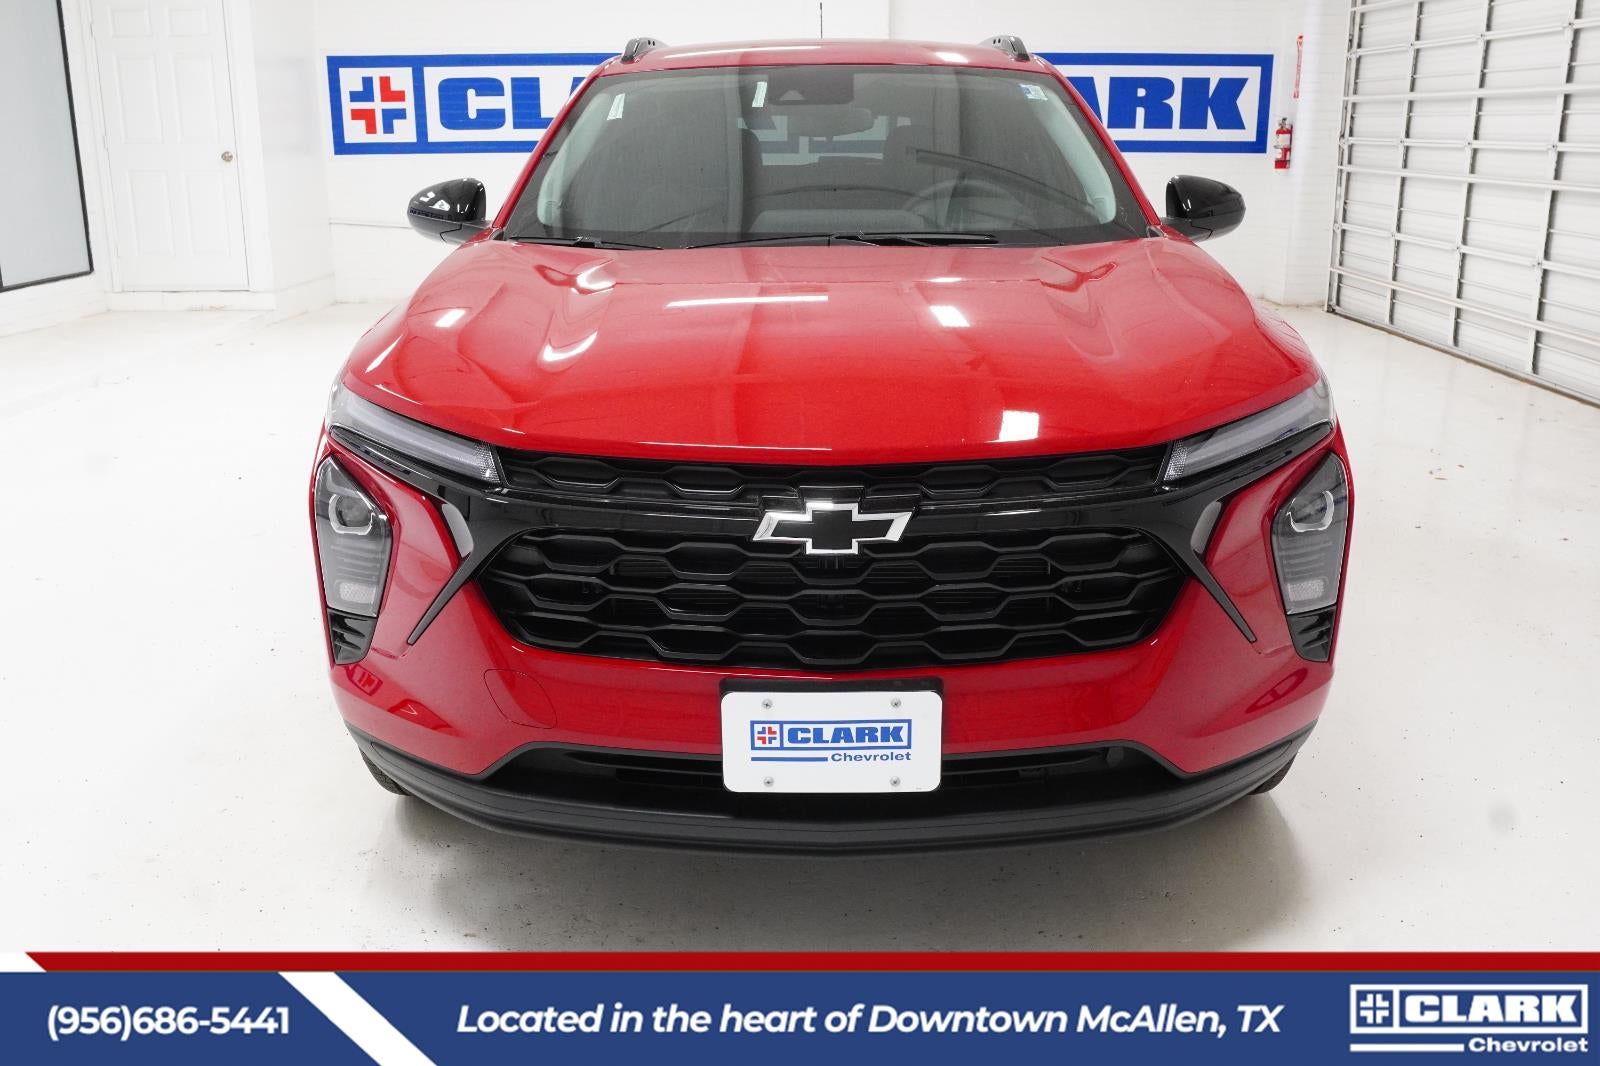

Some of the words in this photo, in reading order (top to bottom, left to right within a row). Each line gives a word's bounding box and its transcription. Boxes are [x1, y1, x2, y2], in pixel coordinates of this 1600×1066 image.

[437, 76, 584, 131] CL
[787, 726, 904, 744] CLARK
[831, 751, 911, 762] Chevrolet
